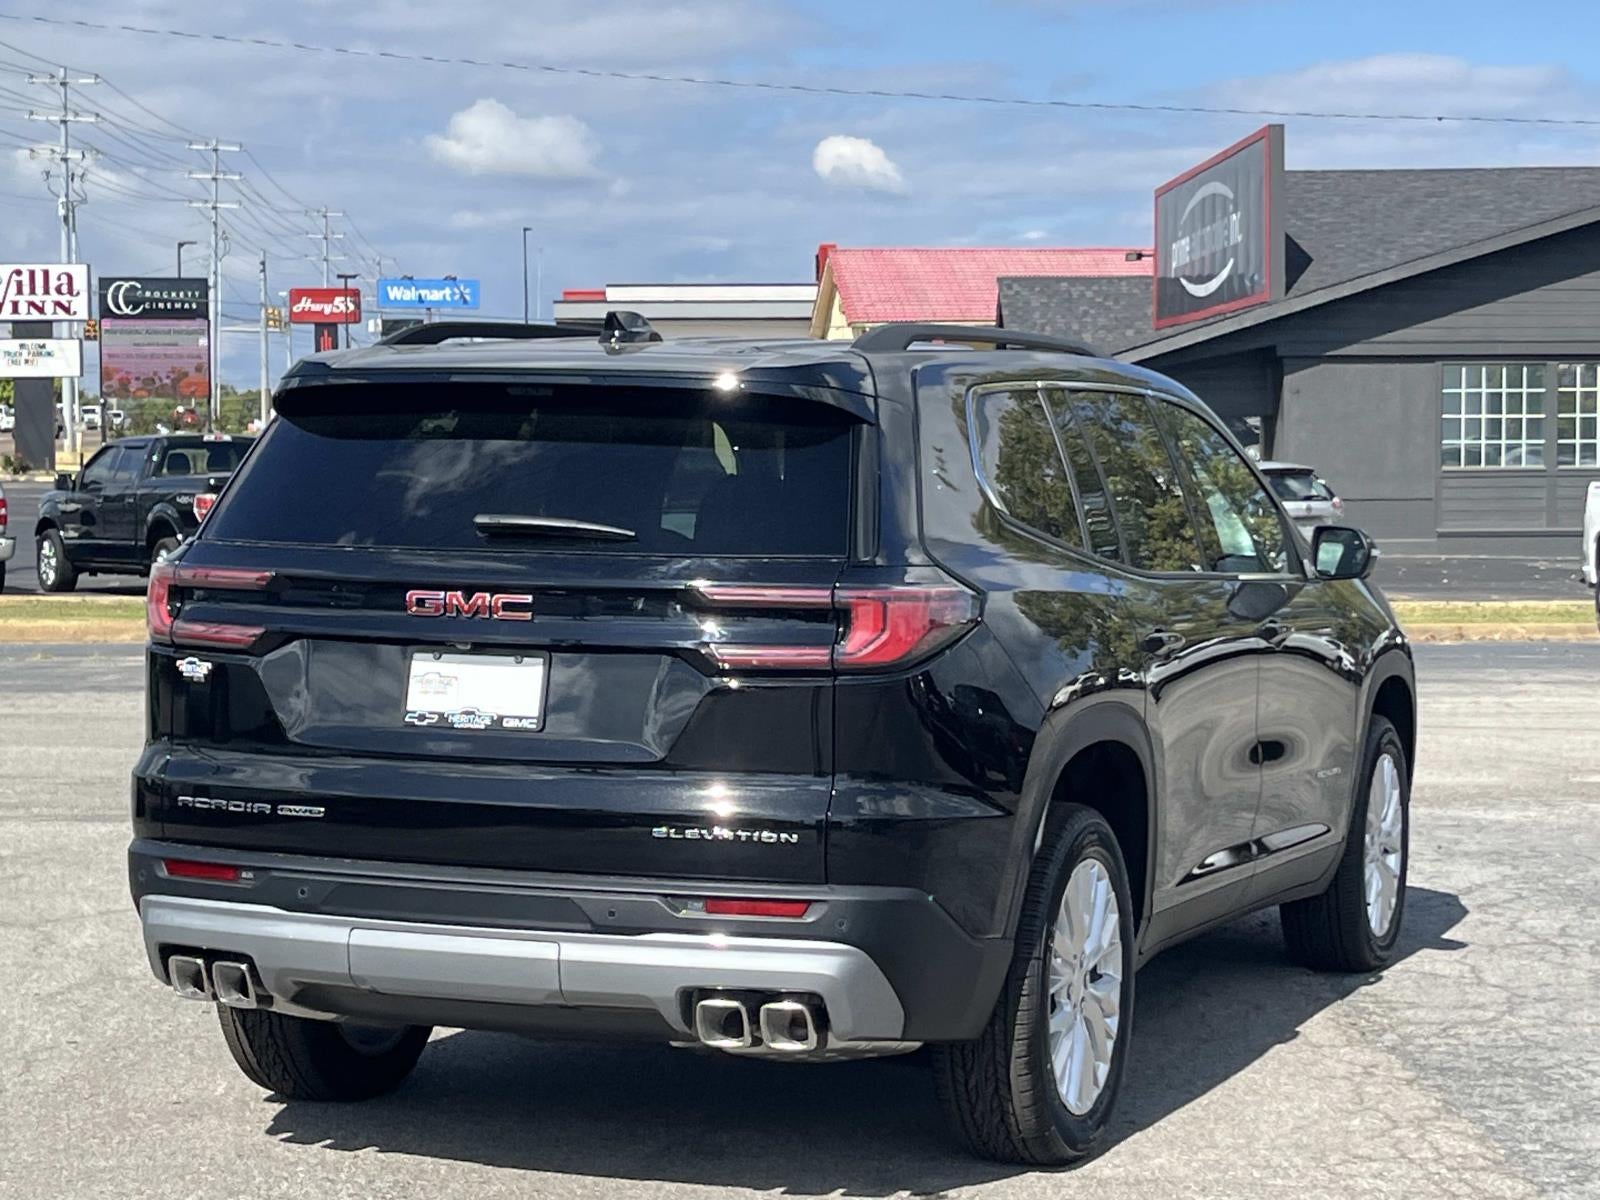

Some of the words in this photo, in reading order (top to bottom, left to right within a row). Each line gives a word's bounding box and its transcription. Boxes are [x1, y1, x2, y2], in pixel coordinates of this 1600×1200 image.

[136, 290, 200, 299] CROCKETT
[387, 285, 452, 301] Walmart
[9, 299, 78, 316] INN
[144, 301, 198, 310] CINEMAS
[27, 350, 55, 358] PARKING
[405, 589, 534, 622] GMC
[447, 713, 493, 725] HERITAGE
[502, 717, 539, 729] GMC
[177, 795, 273, 815] ACADIA
[277, 804, 326, 818] AWD
[651, 825, 799, 844] ELEVATION
